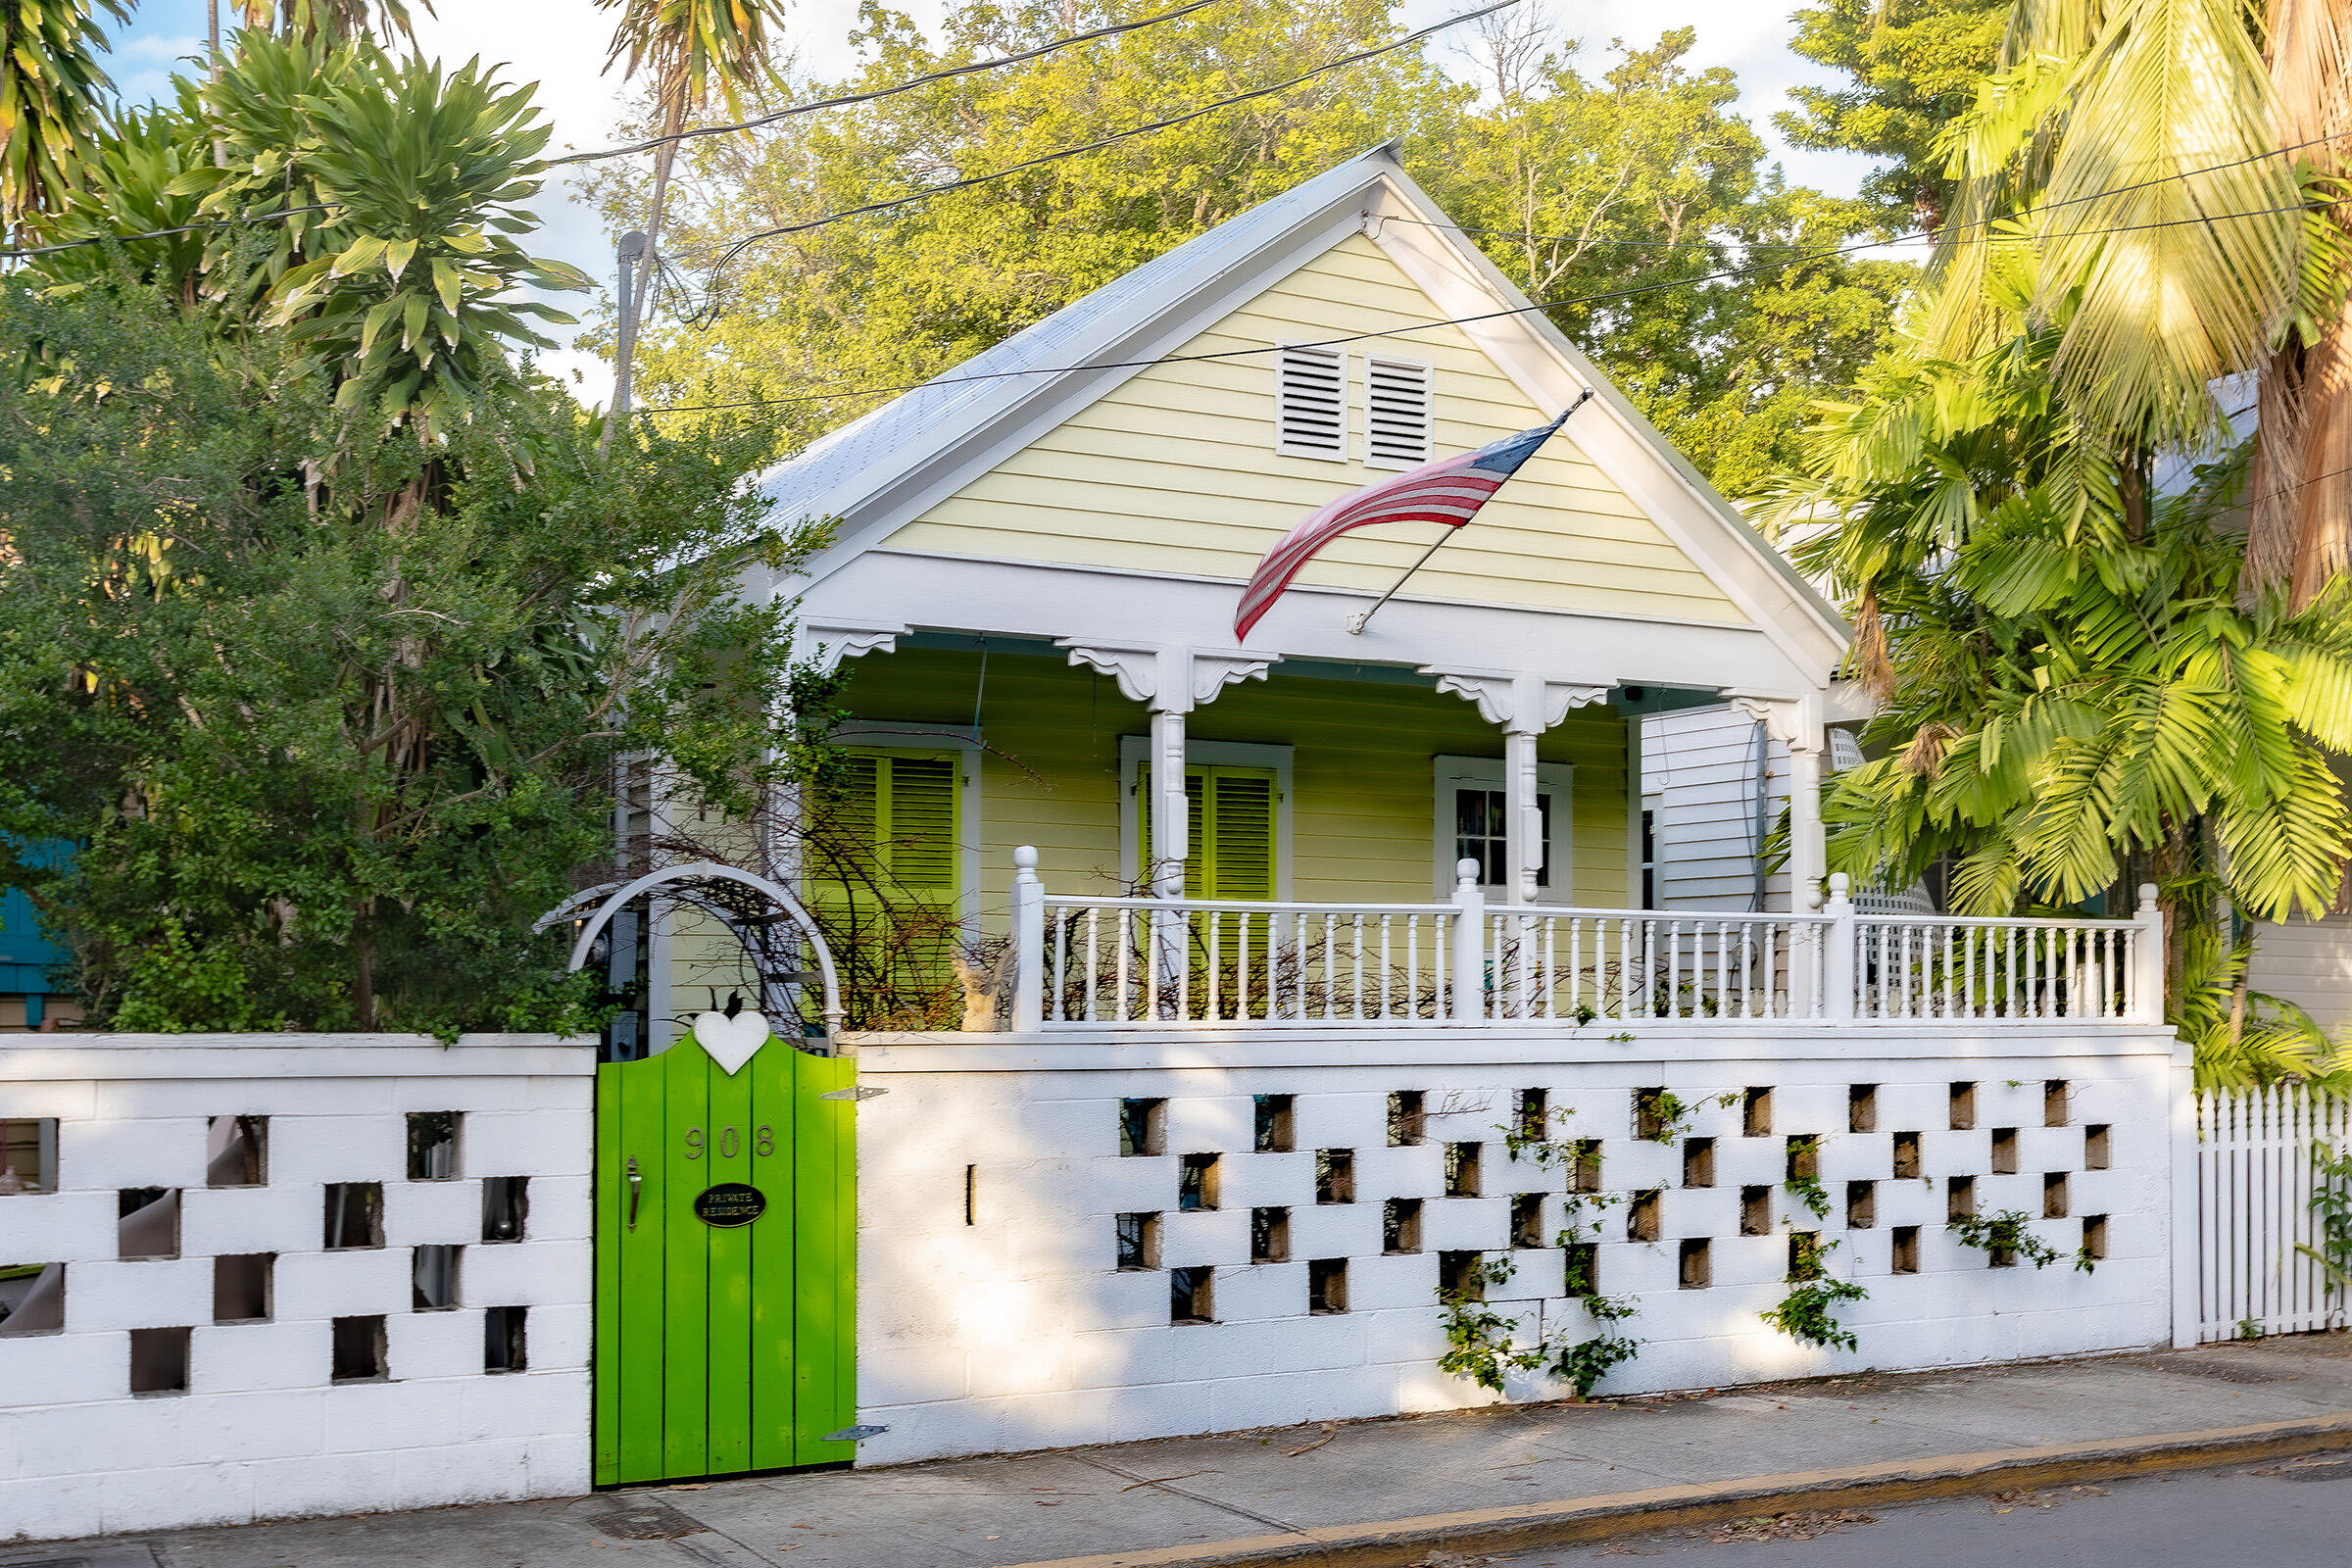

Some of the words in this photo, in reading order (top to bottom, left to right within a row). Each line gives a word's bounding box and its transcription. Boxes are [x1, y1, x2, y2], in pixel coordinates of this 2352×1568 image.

[685, 1124, 774, 1159] 908
[709, 1193, 754, 1203] PRIVATE
[702, 1205, 760, 1217] RESIDENCE
